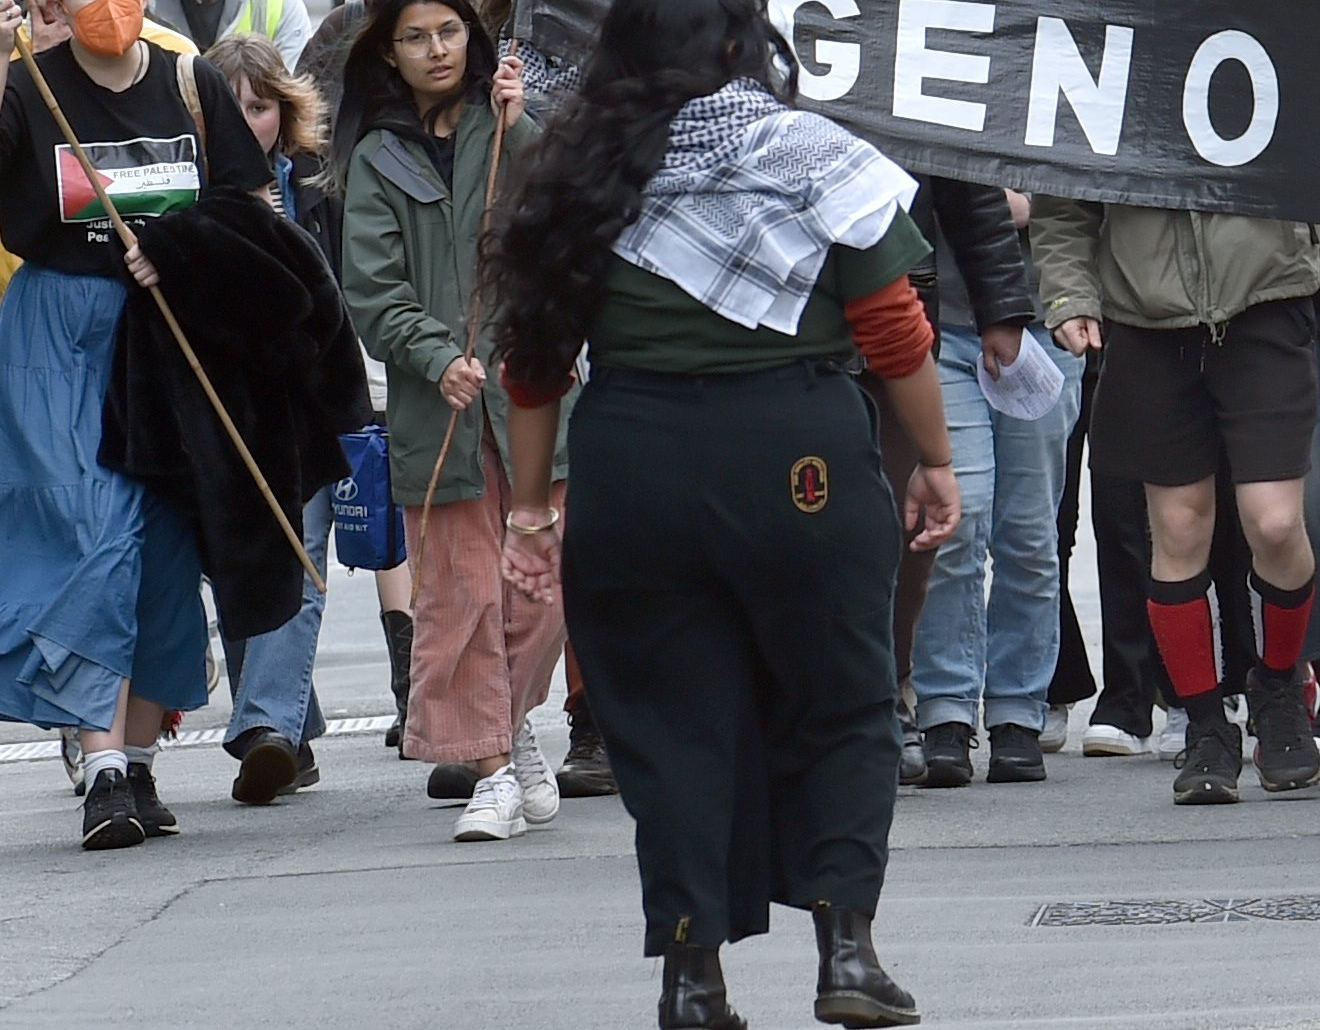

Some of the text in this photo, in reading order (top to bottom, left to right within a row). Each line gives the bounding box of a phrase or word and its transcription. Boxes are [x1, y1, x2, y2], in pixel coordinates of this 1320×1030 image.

[113, 163, 196, 179] FREE PALESTINE
[87, 231, 109, 243] Pea
[332, 504, 368, 517] YUNDAI
